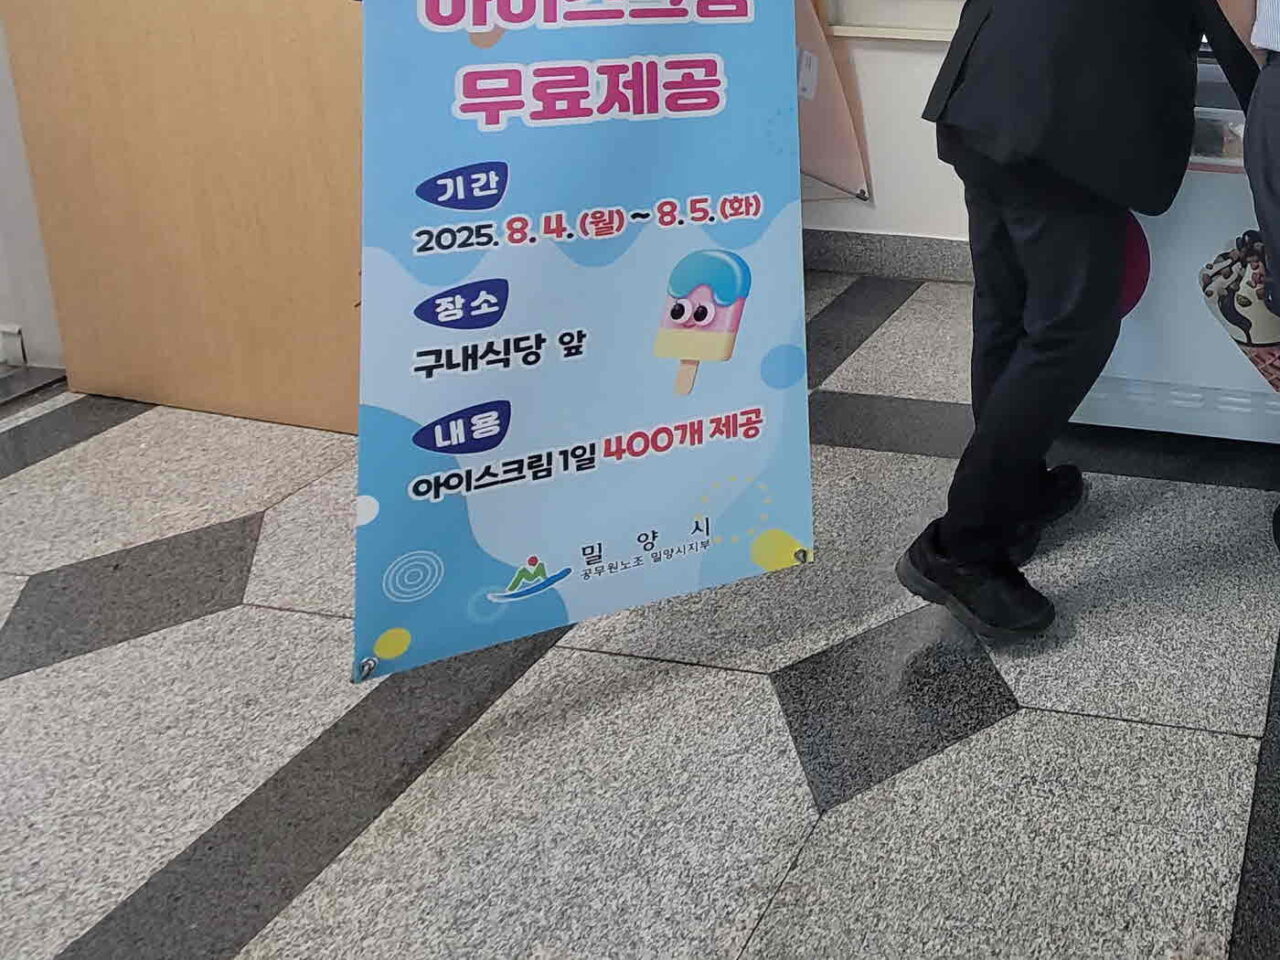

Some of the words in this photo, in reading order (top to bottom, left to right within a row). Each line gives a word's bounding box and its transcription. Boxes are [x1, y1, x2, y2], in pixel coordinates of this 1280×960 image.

[458, 58, 722, 125] 무료제공
[413, 332, 547, 379] 구내식당
[558, 329, 587, 358] 앞
[580, 555, 643, 581] 공무원노조
[650, 540, 710, 563] 밀양시지부
